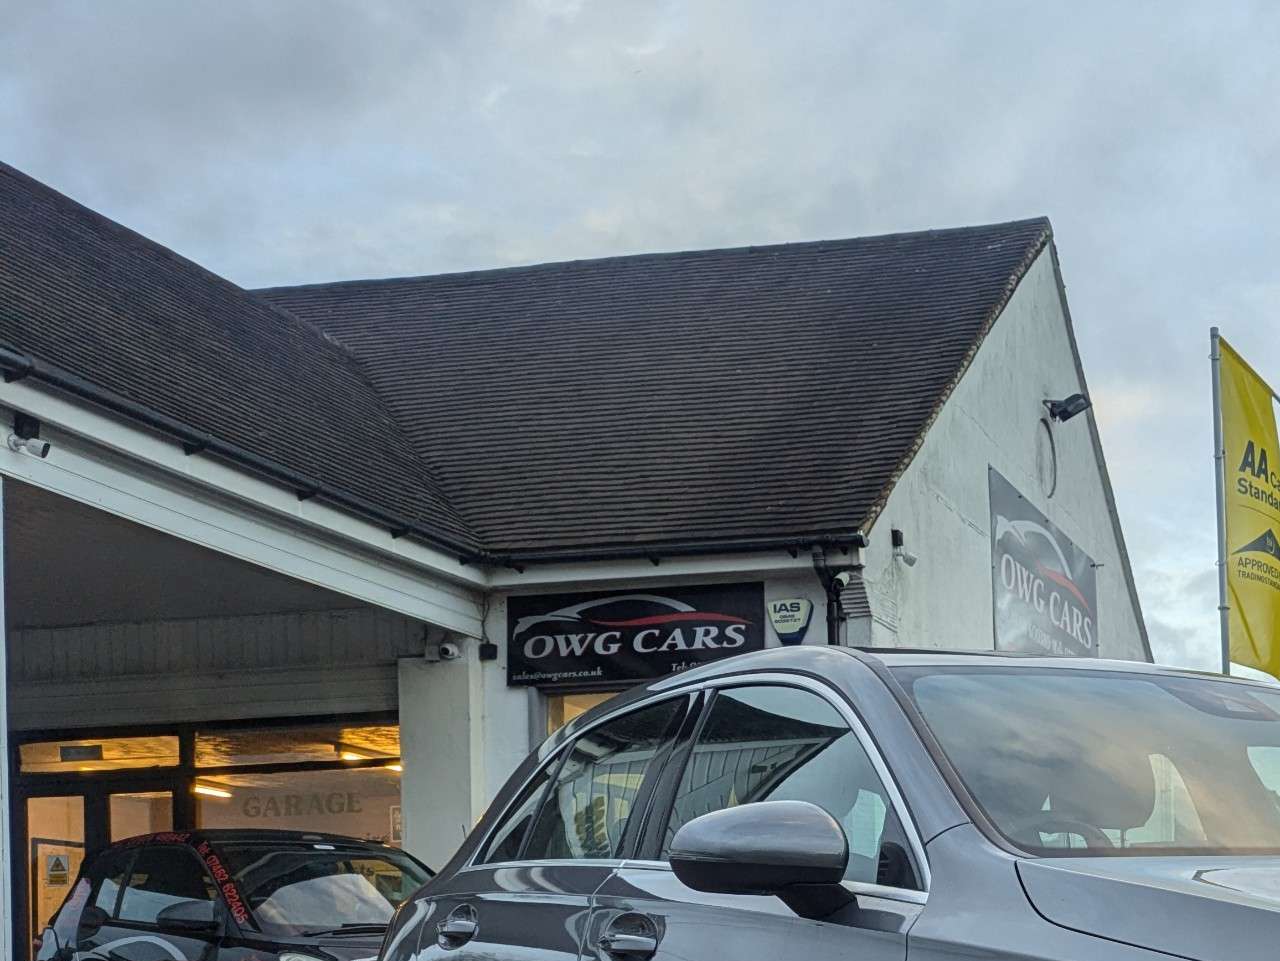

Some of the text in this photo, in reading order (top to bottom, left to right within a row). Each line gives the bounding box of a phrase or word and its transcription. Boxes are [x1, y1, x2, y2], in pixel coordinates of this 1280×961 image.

[1239, 440, 1269, 484] AA
[773, 602, 801, 614] IAS
[1000, 553, 1045, 614] OWG
[1050, 591, 1092, 649] CARS
[523, 624, 746, 659] OWG CARS
[242, 791, 363, 818] GARAGE
